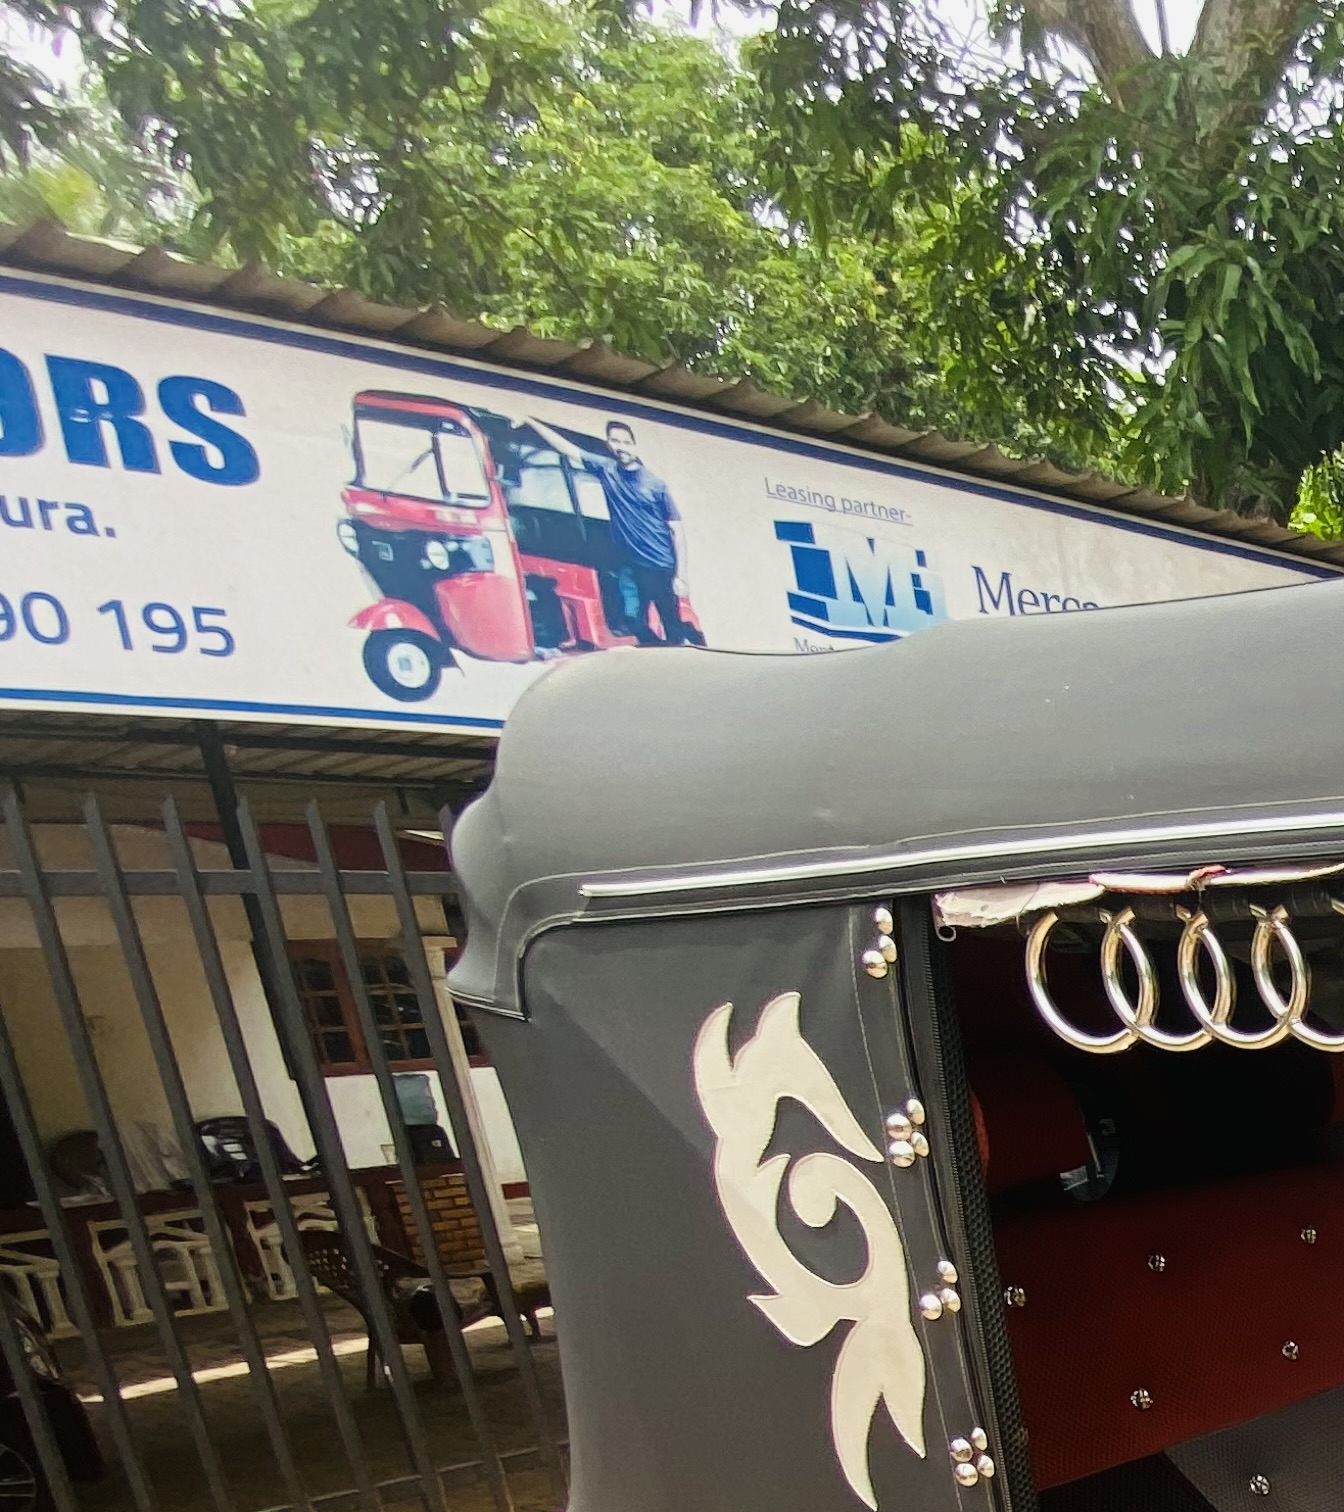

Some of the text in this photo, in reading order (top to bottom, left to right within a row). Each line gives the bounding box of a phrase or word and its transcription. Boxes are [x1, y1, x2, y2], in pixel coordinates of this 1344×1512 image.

[765, 477, 912, 522] Leasing partner-
[97, 599, 236, 657] 195
